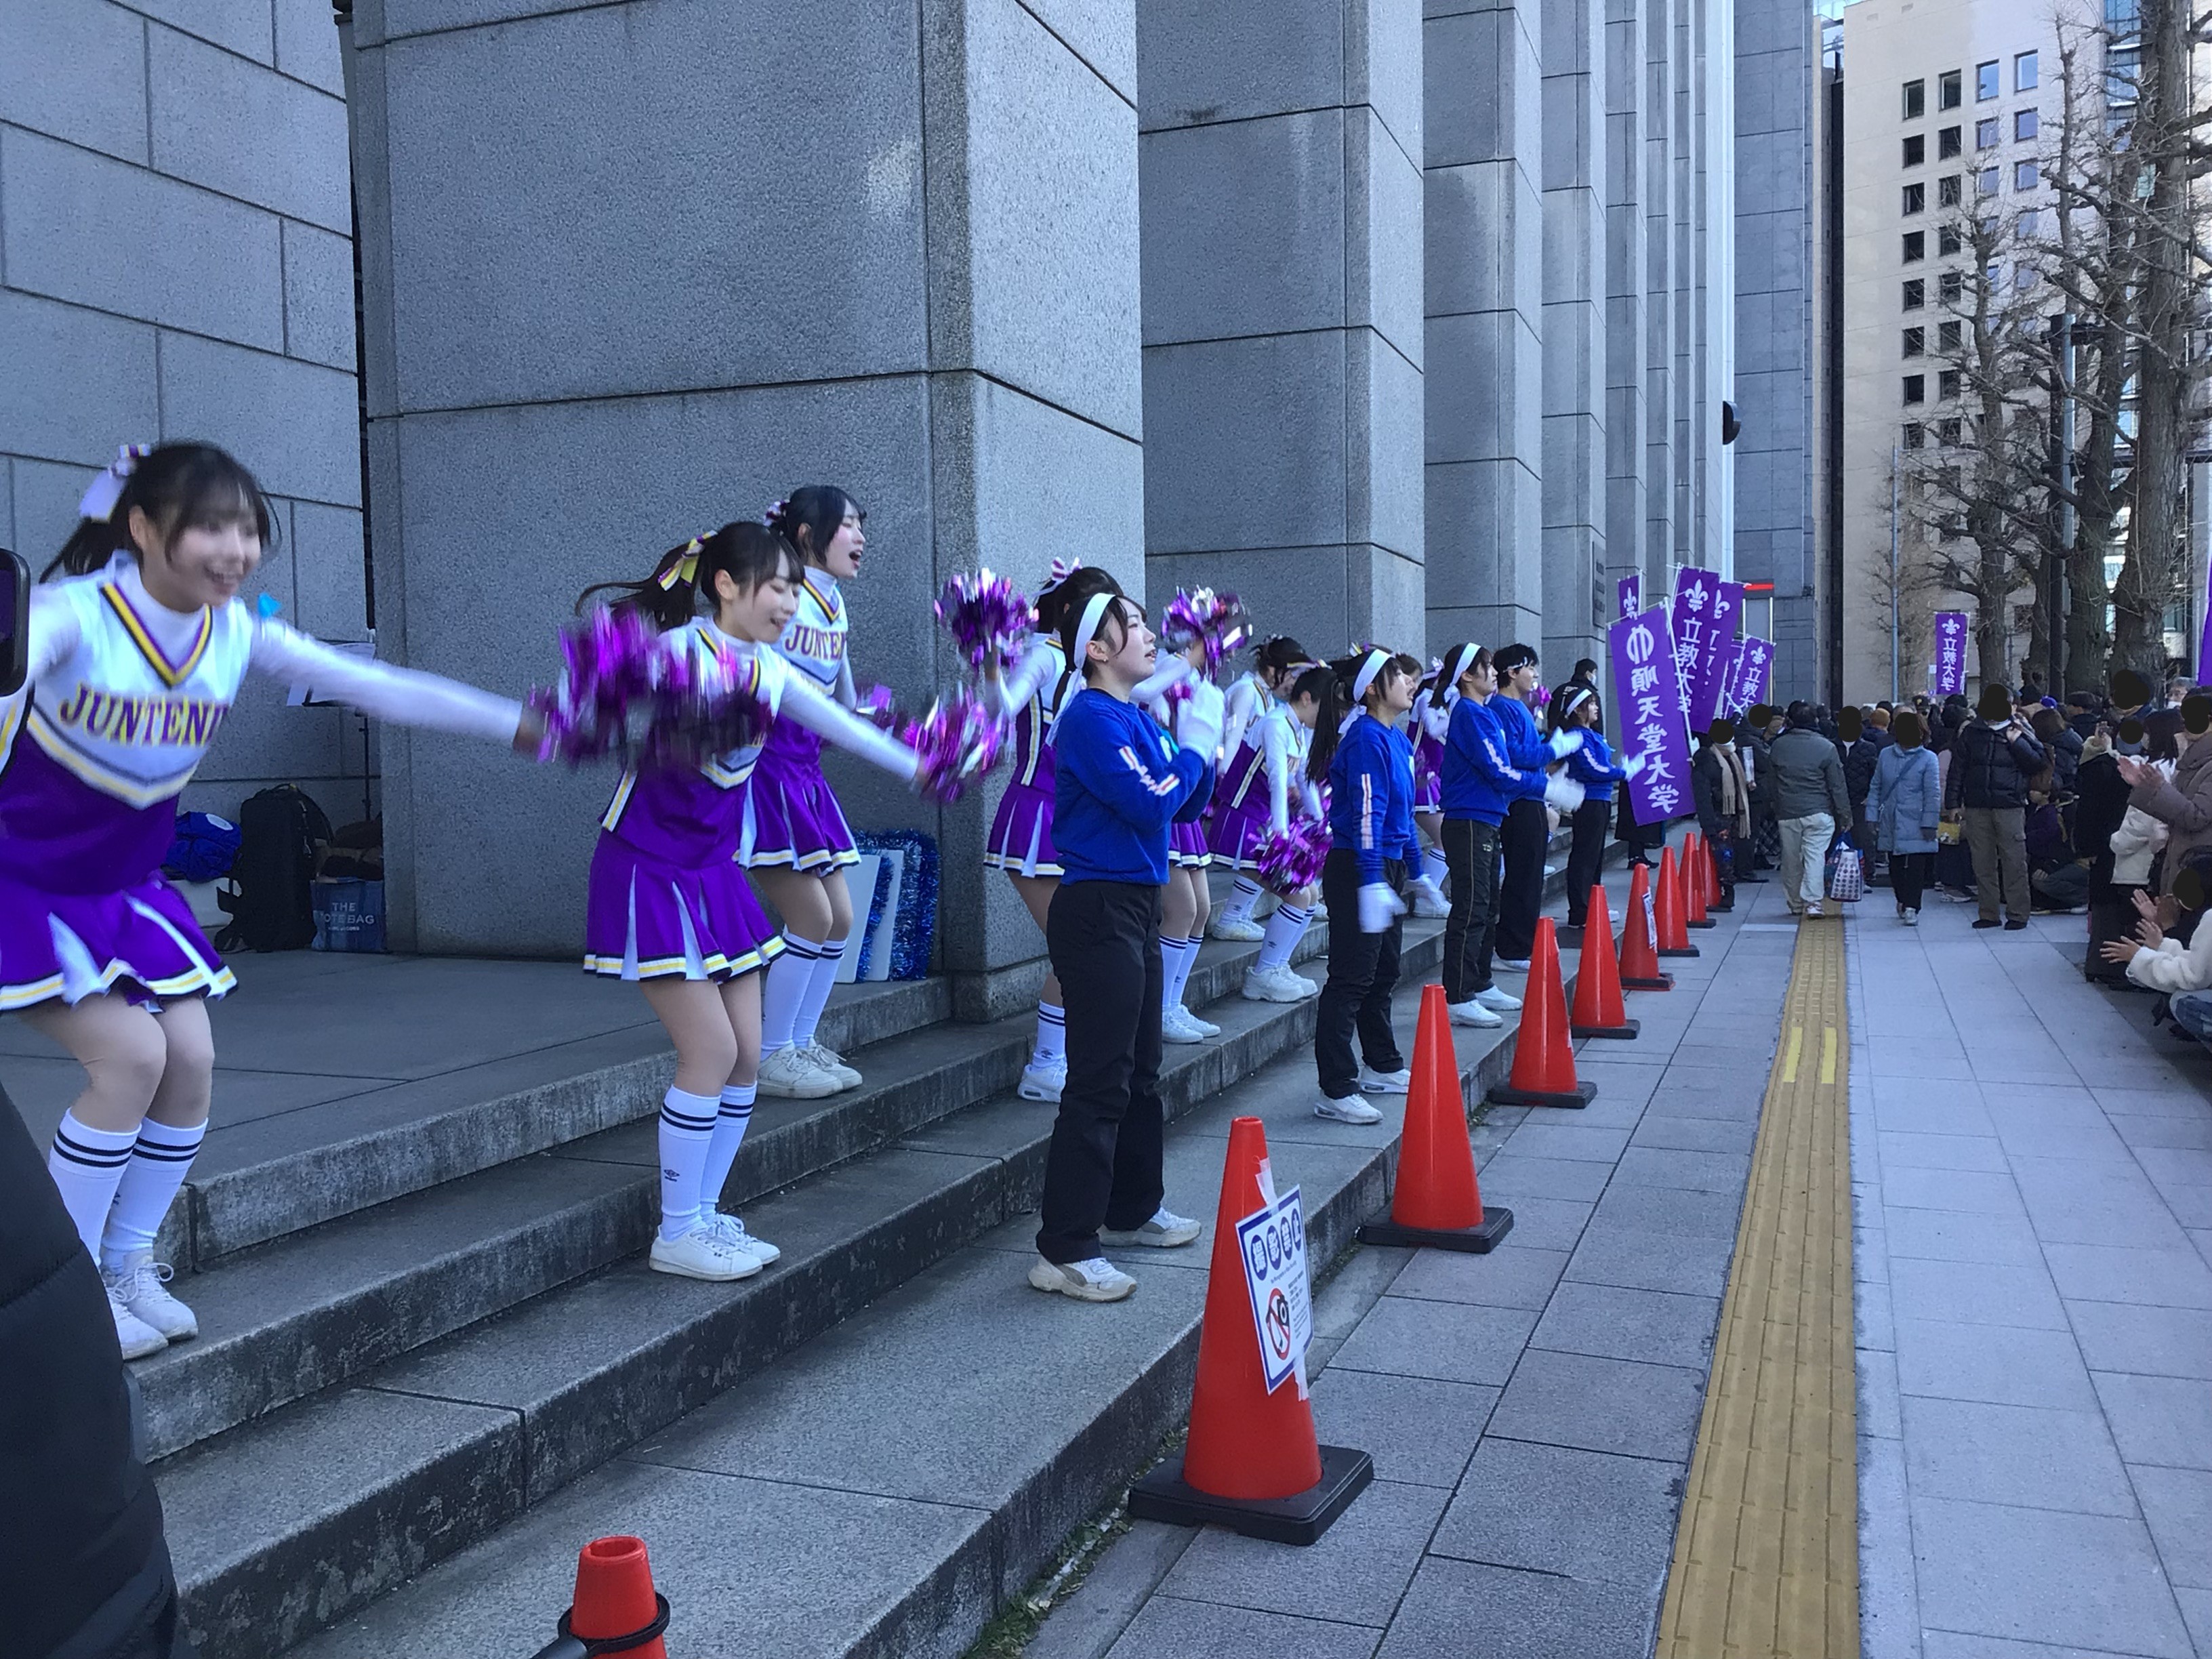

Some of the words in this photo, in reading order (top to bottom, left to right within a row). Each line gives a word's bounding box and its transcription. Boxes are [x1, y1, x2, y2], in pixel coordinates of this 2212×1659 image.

[332, 902, 356, 912] THE
[321, 913, 346, 923] OTE
[347, 914, 375, 924] BAG
